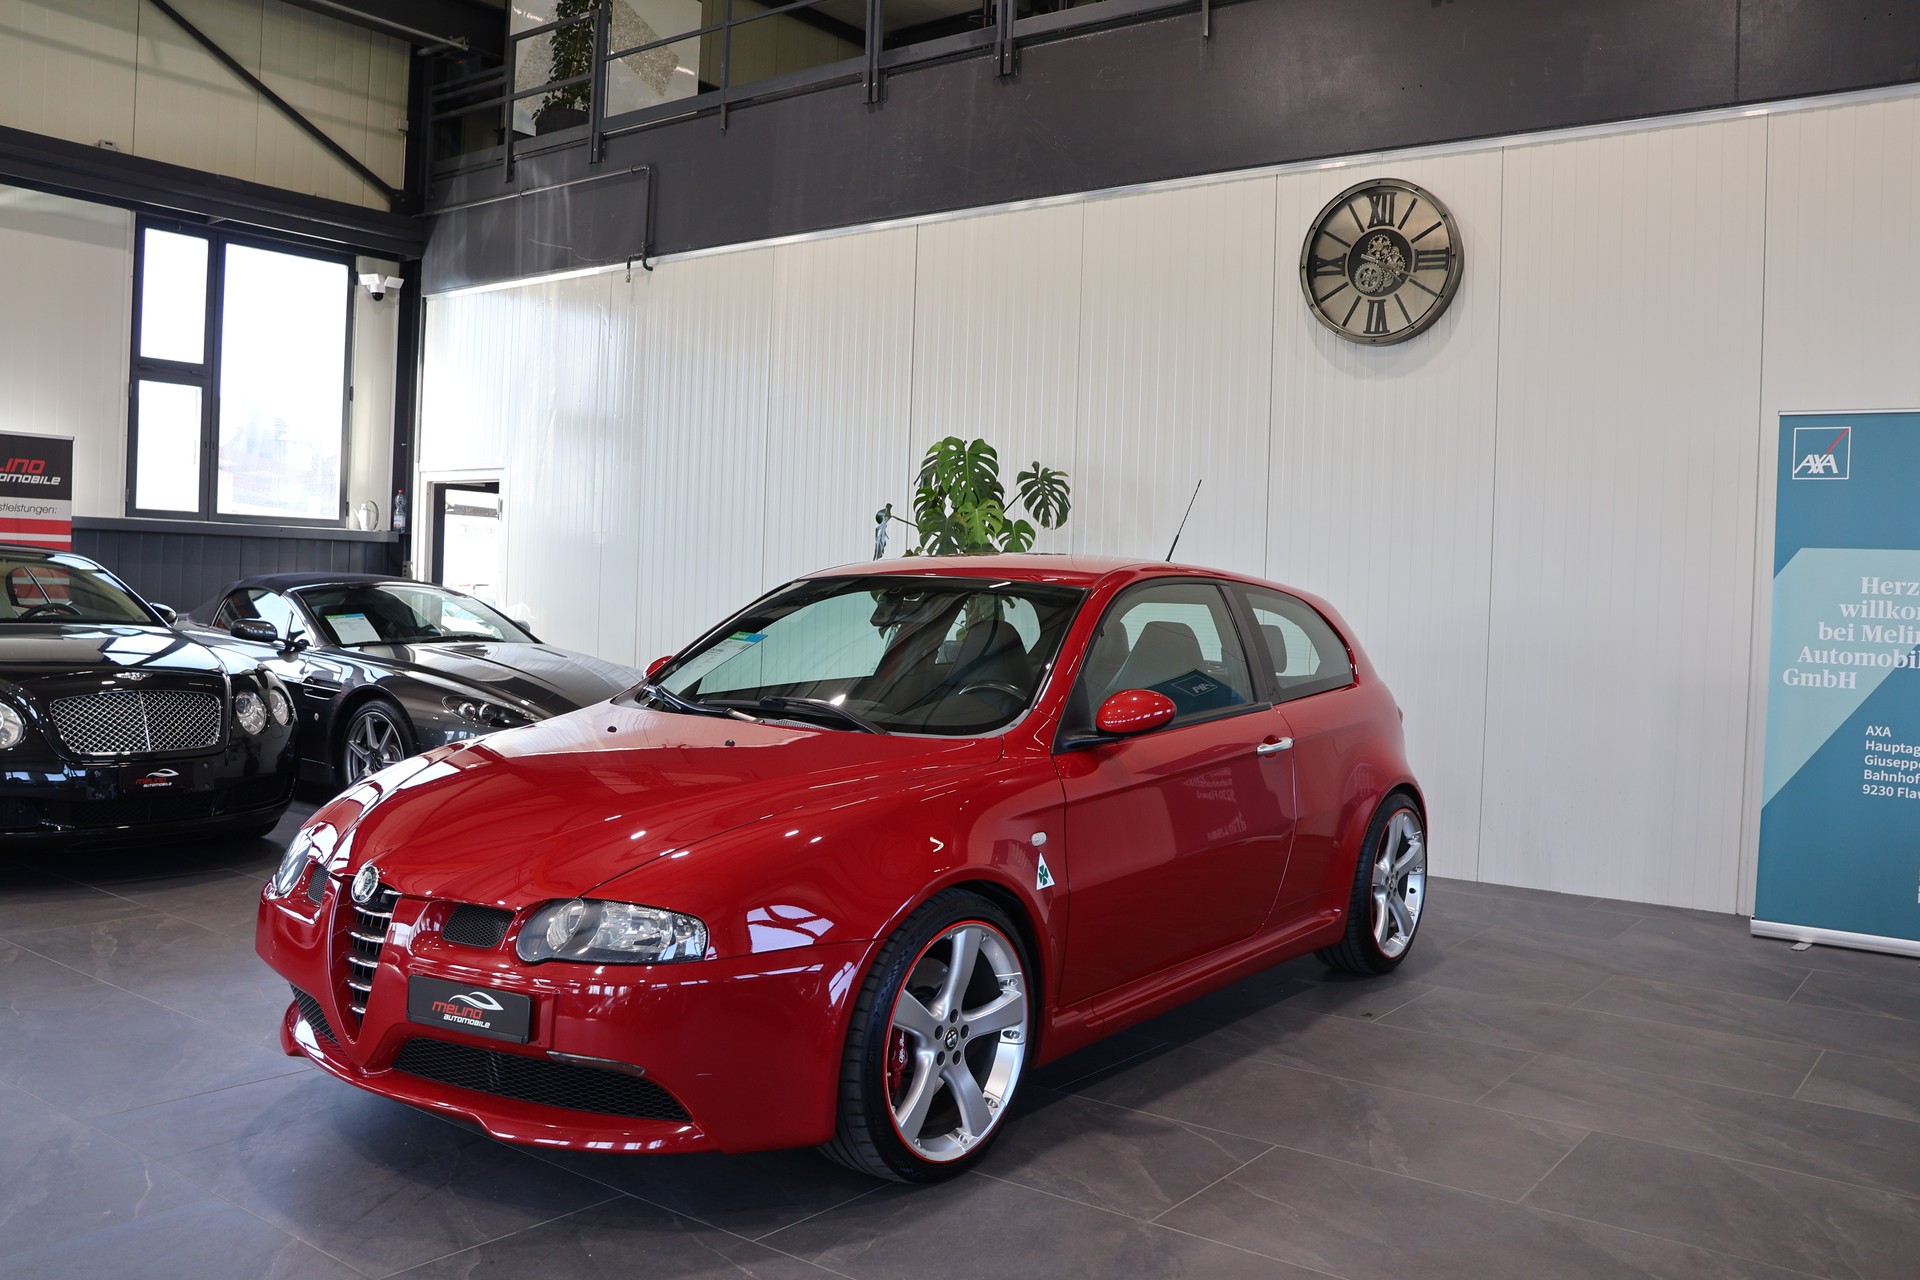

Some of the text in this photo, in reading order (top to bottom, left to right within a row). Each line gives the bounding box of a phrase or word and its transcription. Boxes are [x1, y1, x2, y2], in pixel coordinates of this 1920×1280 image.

[1366, 191, 1397, 229] XII
[1414, 247, 1450, 273] III
[1794, 454, 1839, 474] AXA
[1860, 576, 1920, 596] Herz
[1839, 599, 1920, 620] willko
[1818, 622, 1920, 645] bei Meli
[1782, 668, 1858, 690] GmbH
[1865, 725, 1892, 738] AXA
[1865, 739, 1920, 758] Hauptag
[1864, 754, 1920, 772] Giusepp
[1862, 784, 1920, 799] 9230 Fla
